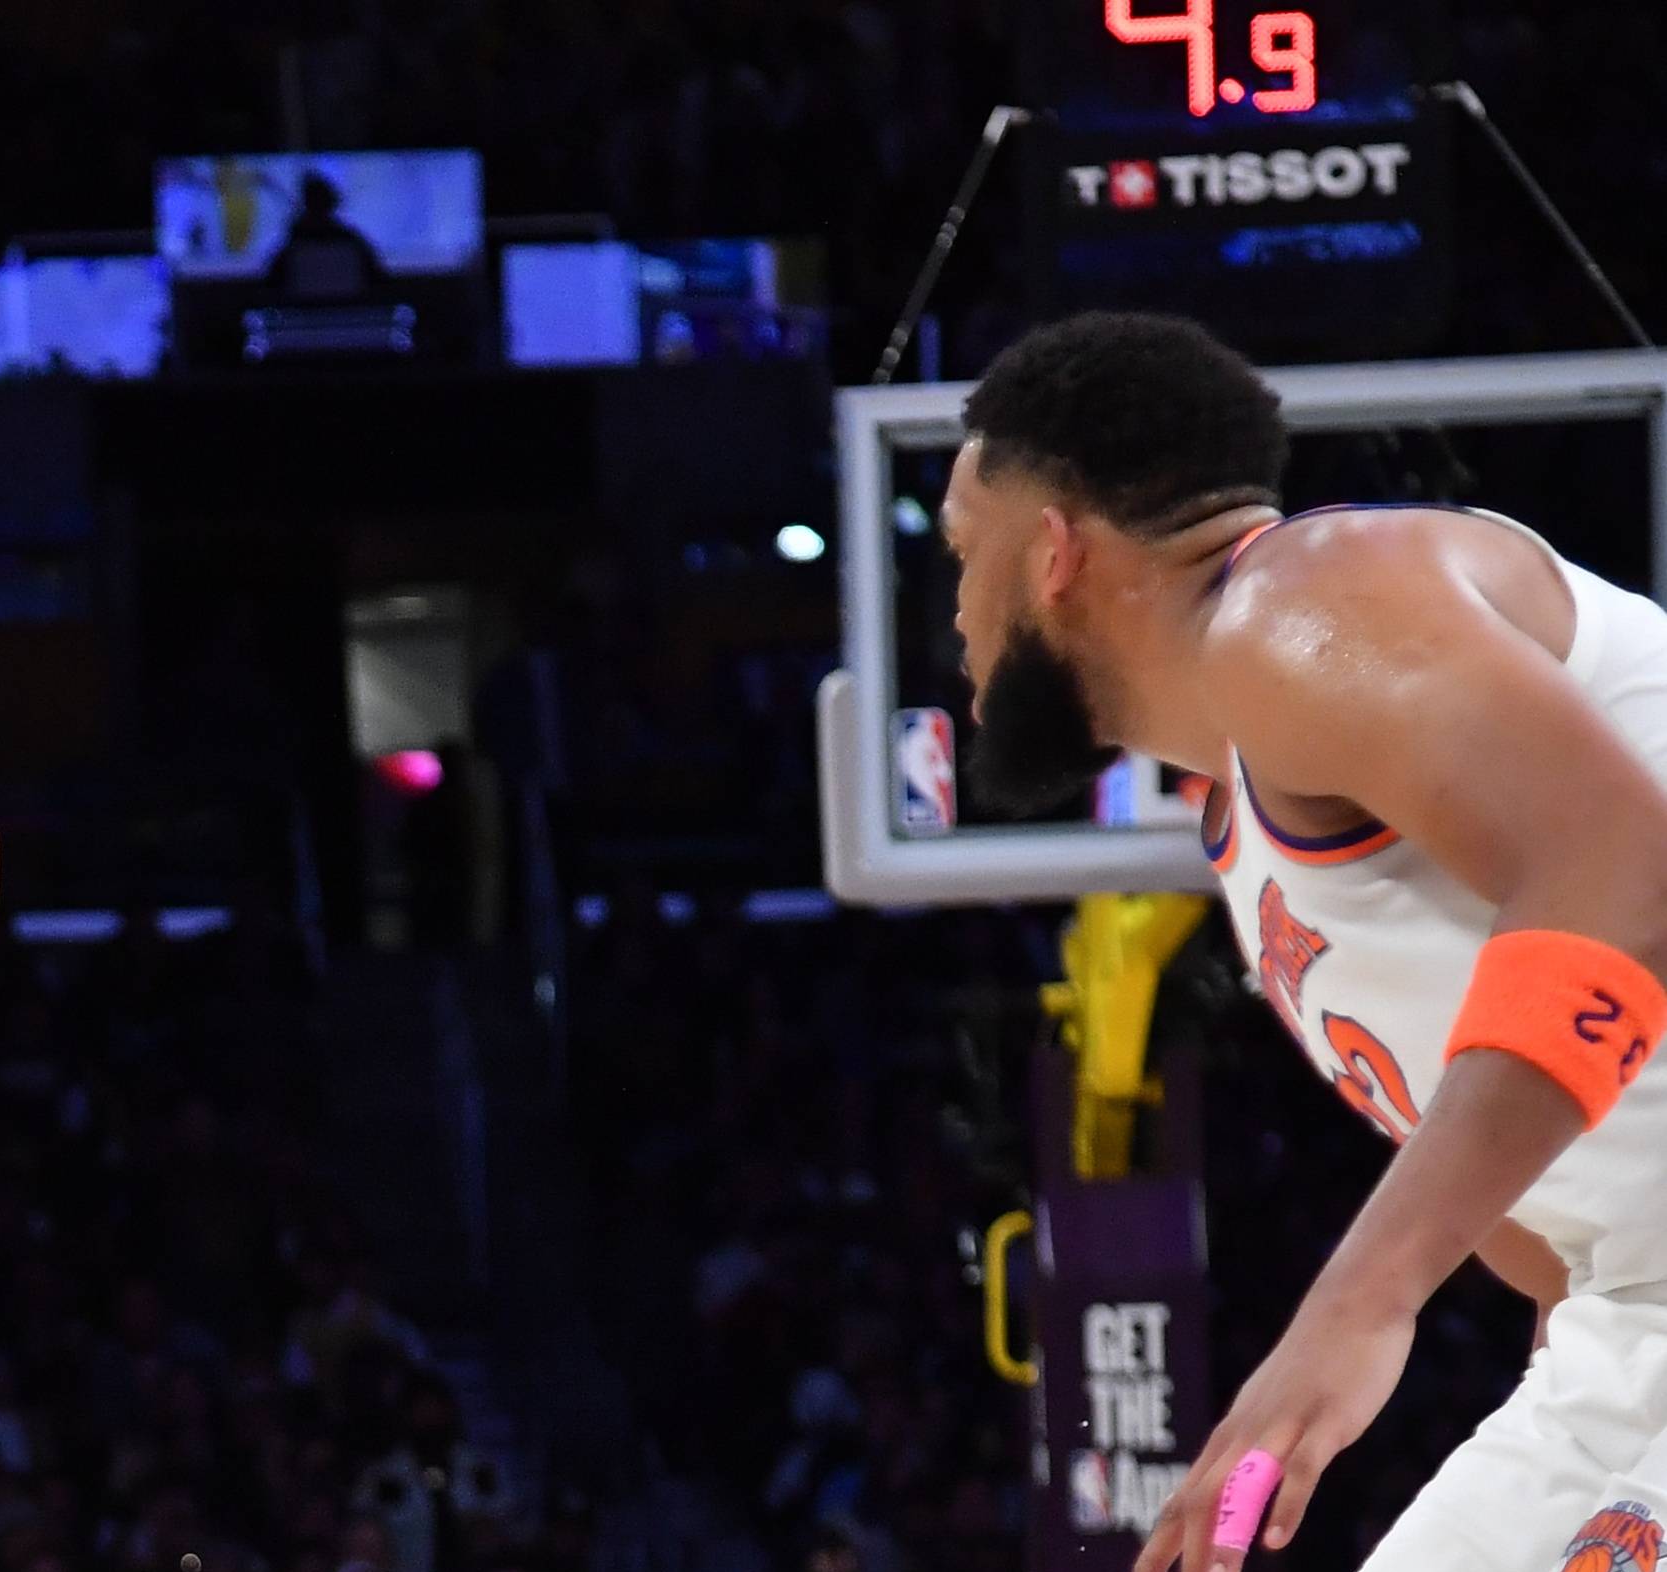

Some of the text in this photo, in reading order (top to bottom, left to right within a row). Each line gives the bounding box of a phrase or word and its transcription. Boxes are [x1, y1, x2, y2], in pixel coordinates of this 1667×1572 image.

[1159, 143, 1412, 206] TISSOT
[1084, 1302, 1172, 1373] GET
[1088, 1376, 1175, 1450] THE
